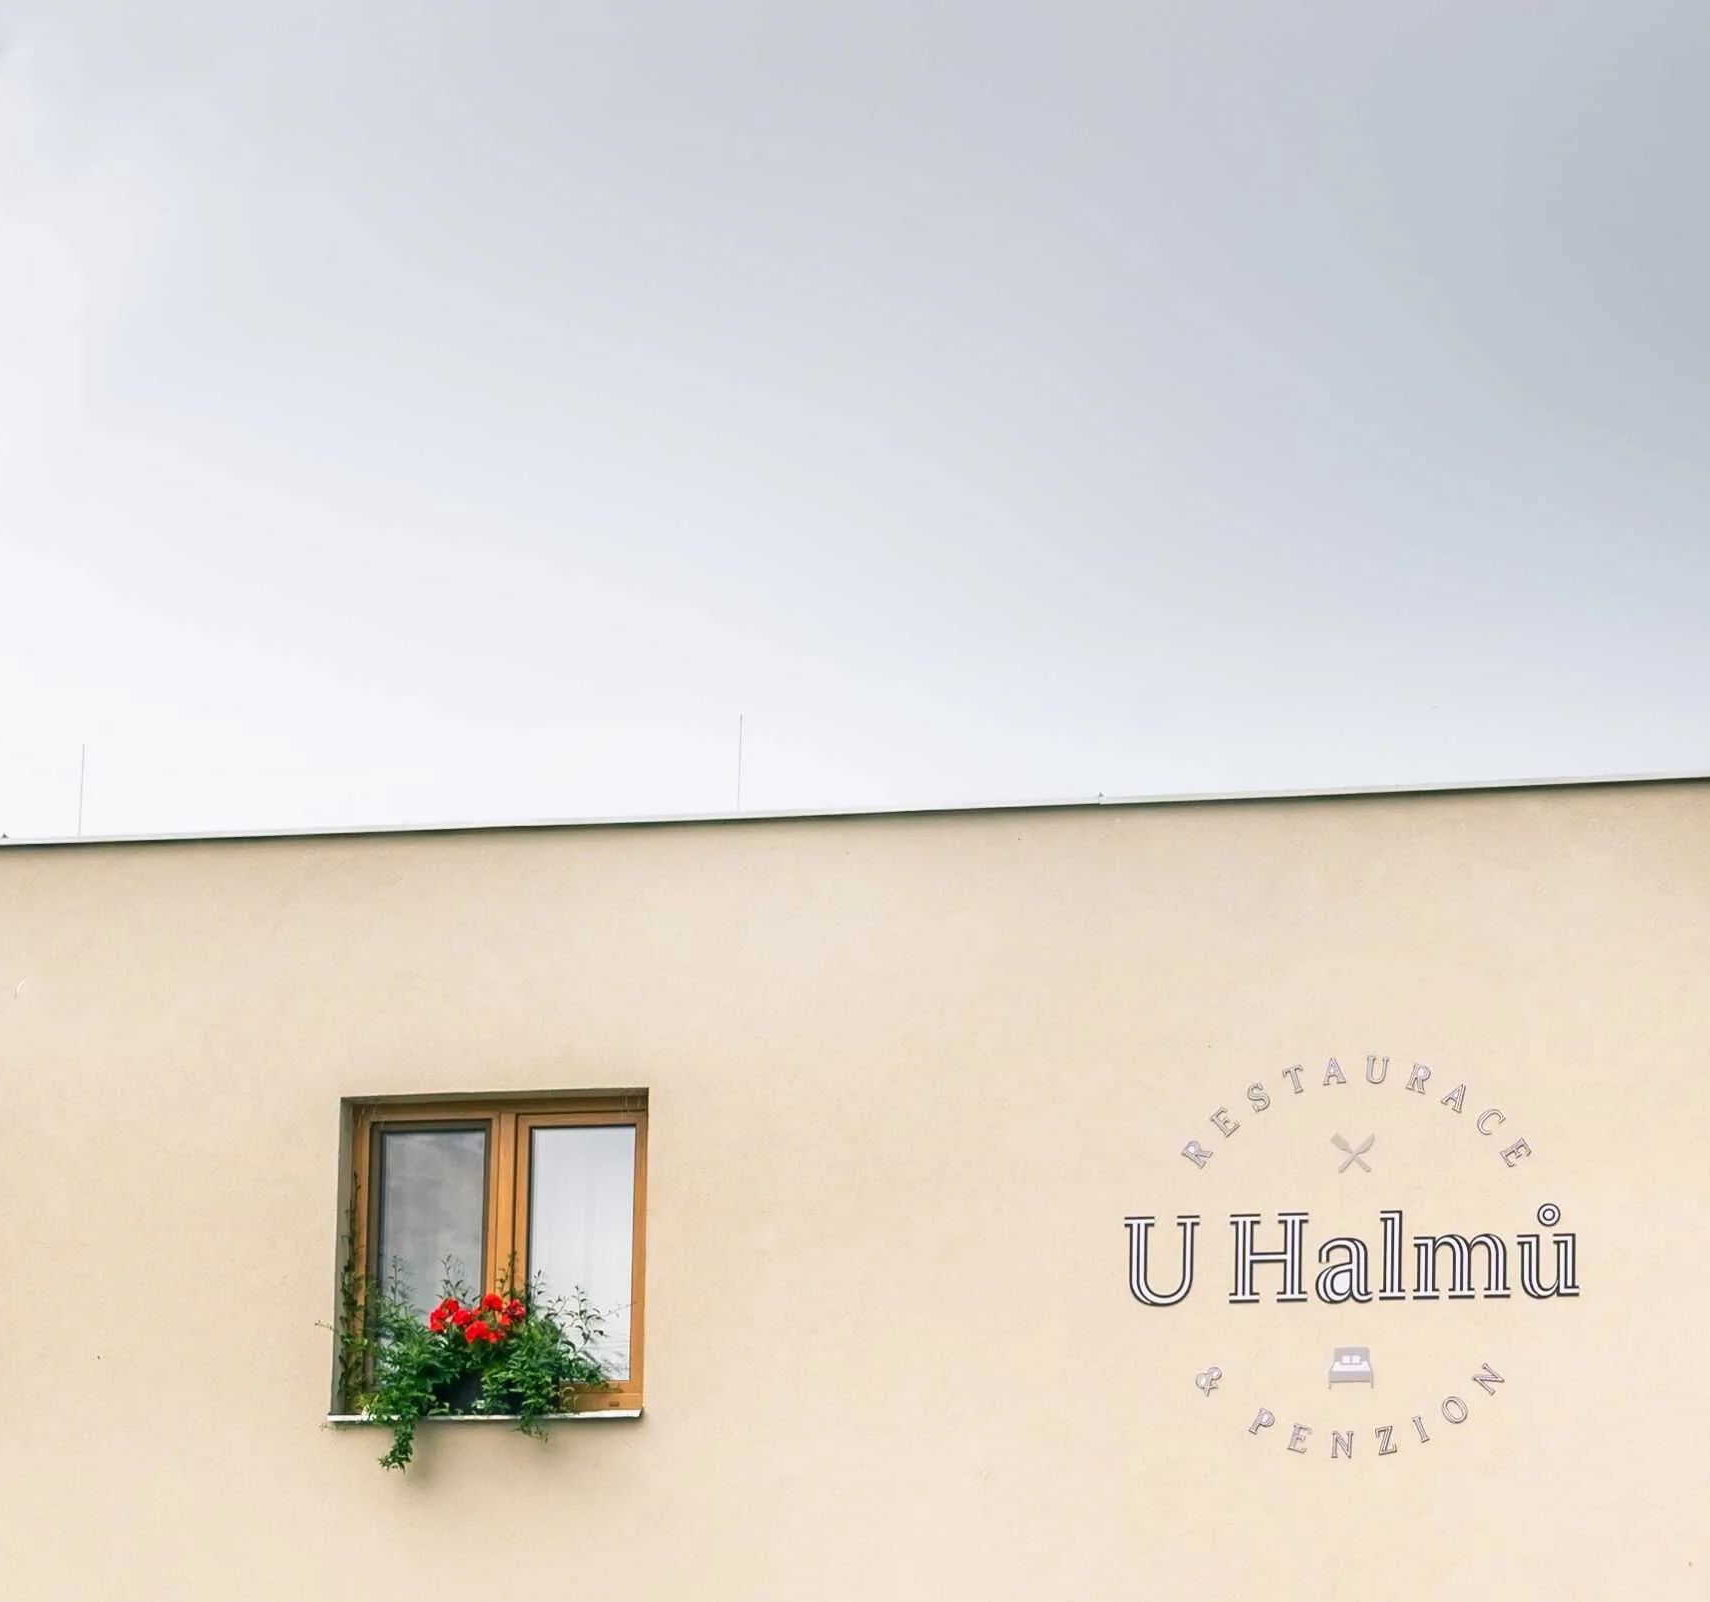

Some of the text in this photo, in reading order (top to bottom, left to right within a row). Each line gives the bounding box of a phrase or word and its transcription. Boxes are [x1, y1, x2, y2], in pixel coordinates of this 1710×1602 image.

[1180, 1055, 1532, 1168] RESTAURACE
[1124, 1203, 1581, 1307] U Halmů
[1195, 1363, 1505, 1460] & PENZION
